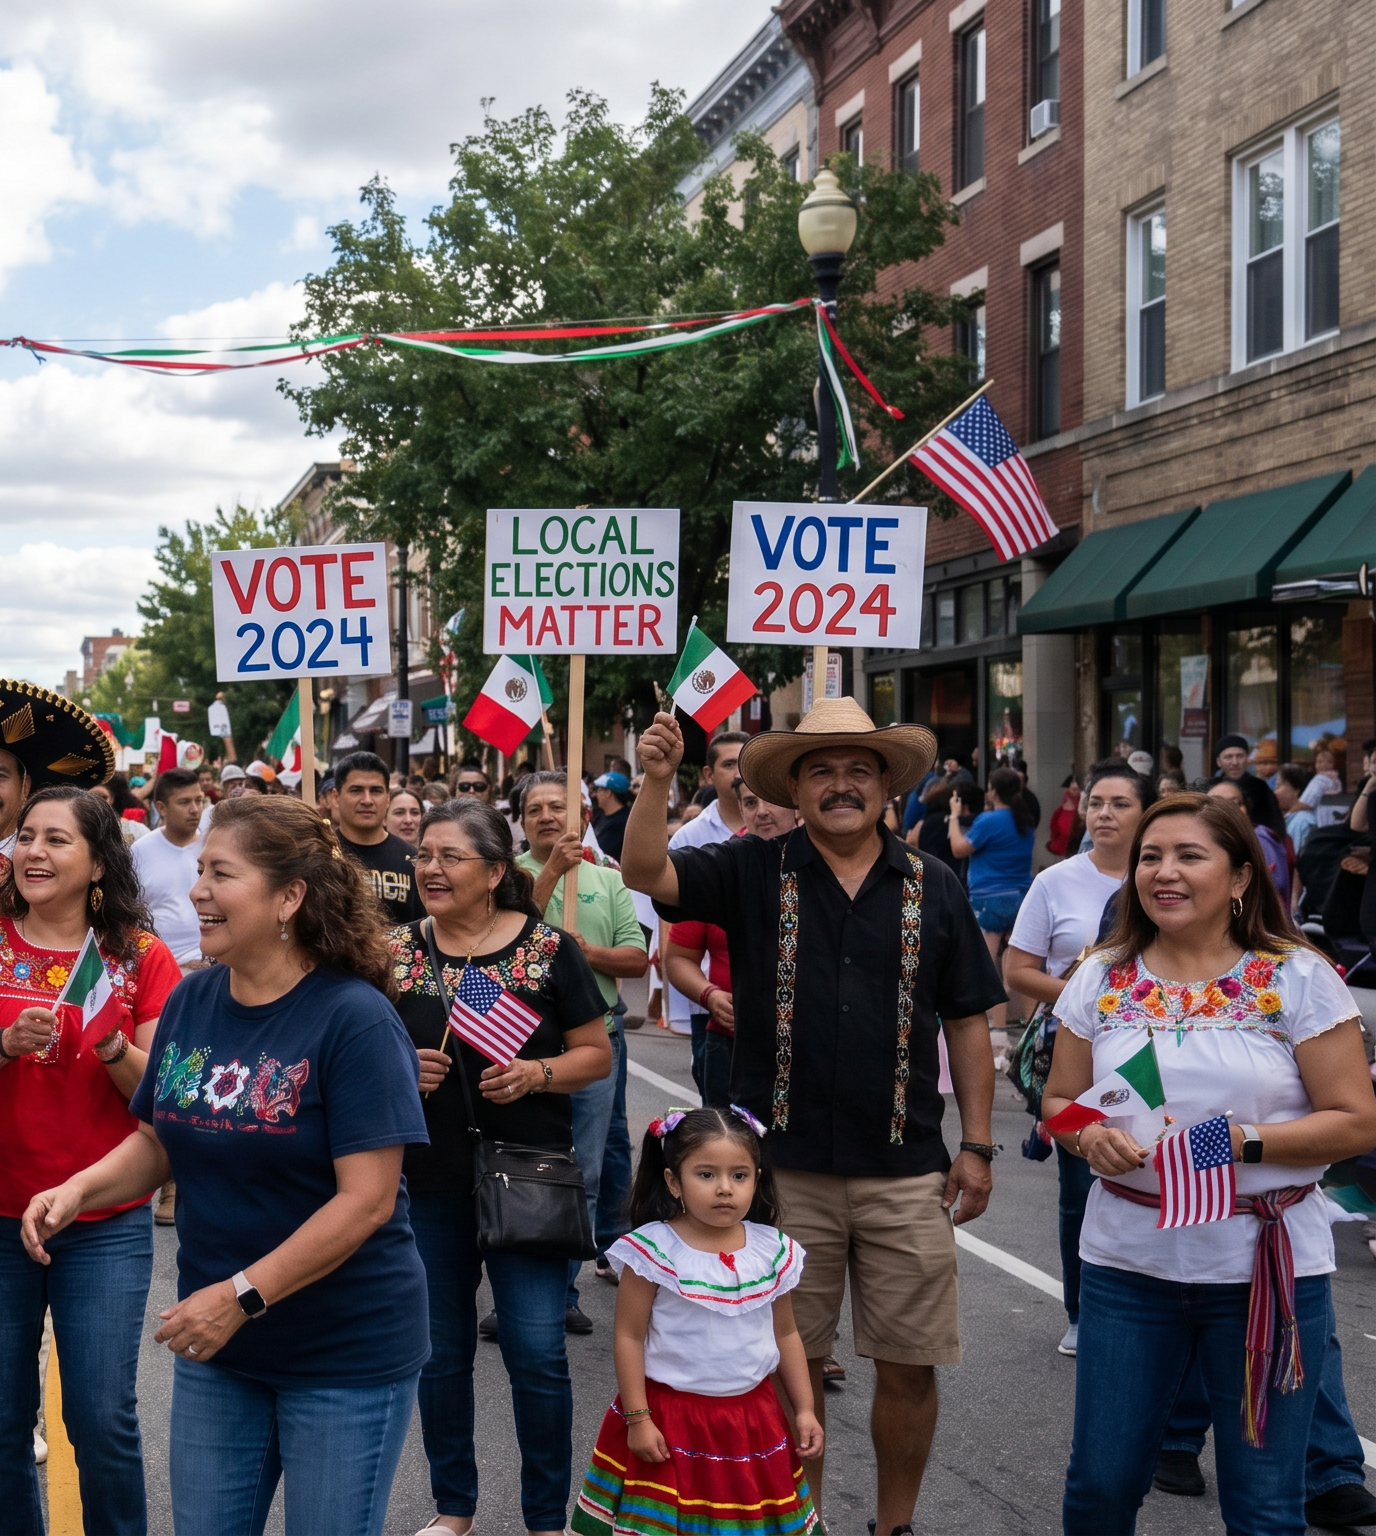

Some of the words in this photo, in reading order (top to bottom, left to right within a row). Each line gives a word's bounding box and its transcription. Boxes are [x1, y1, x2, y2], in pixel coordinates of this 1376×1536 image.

[512, 515, 654, 555] LOCAL
[750, 514, 900, 575] VOTE
[220, 551, 376, 615] VOTE
[491, 561, 675, 598] ELECTIONS
[499, 603, 664, 647] MATTER
[752, 581, 897, 637] 2024
[236, 616, 374, 673] 2024
